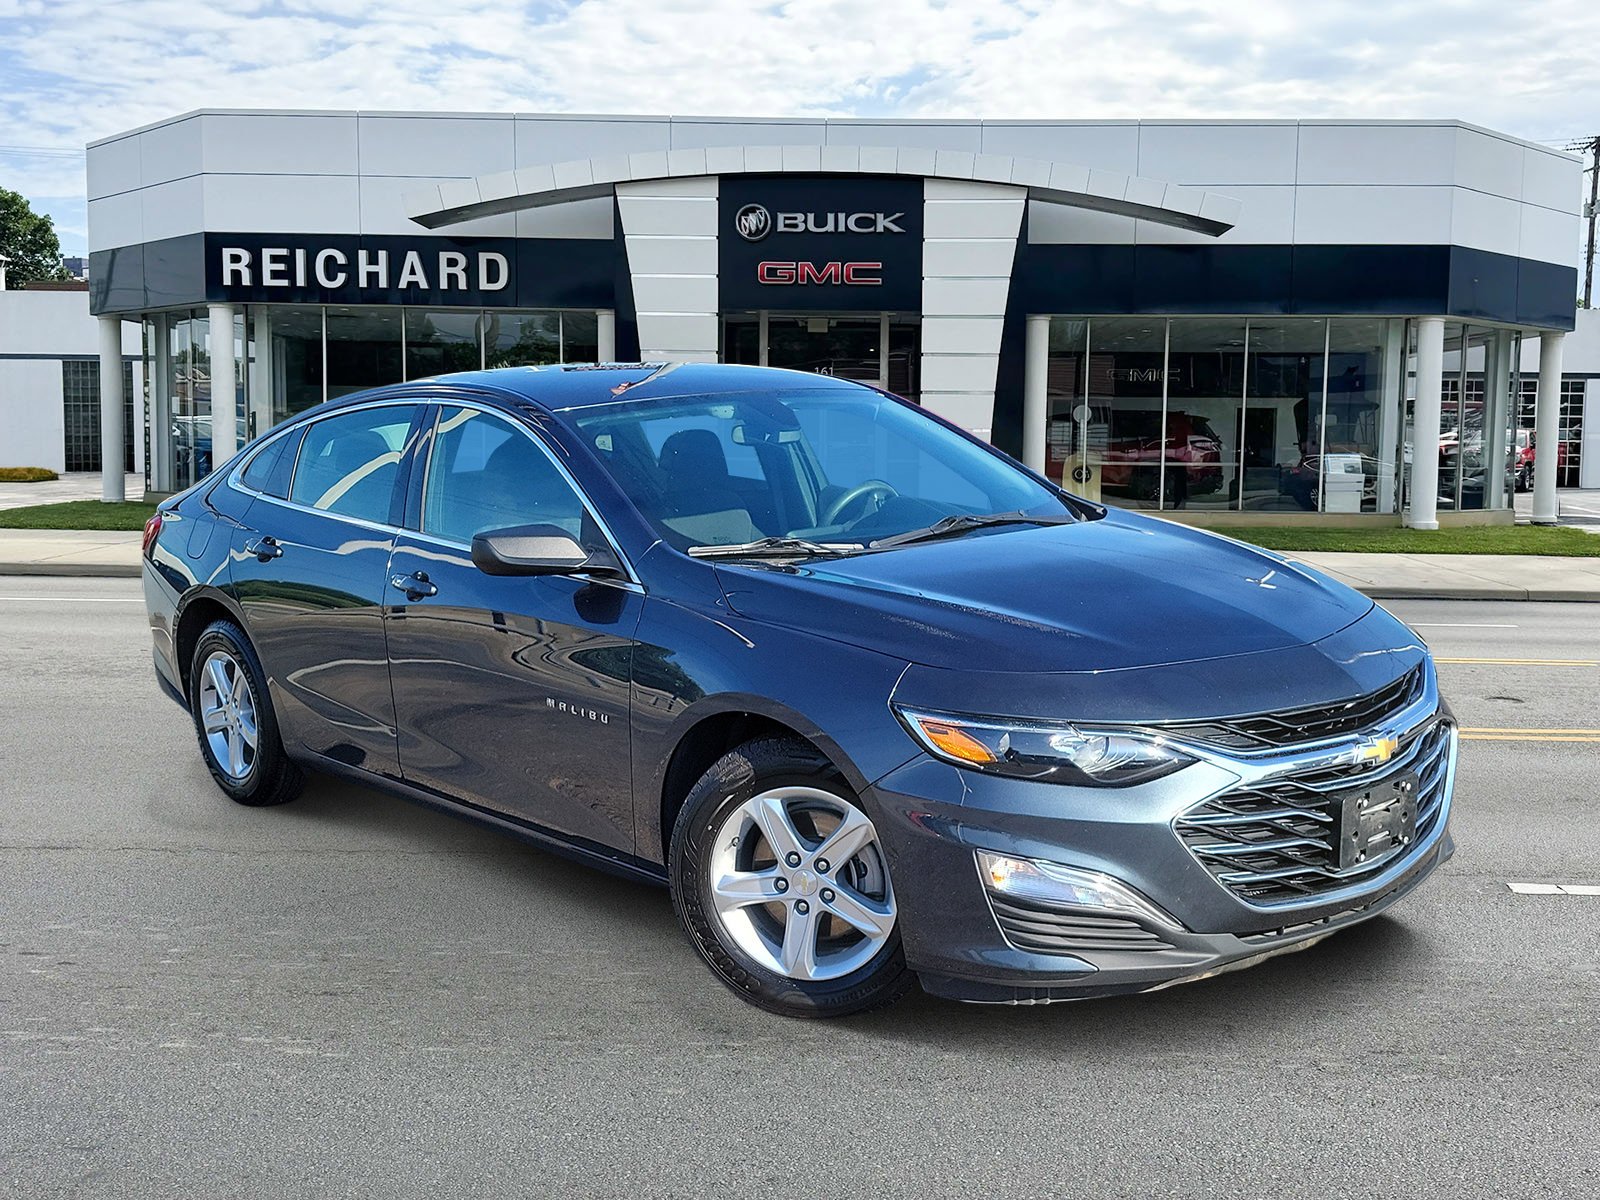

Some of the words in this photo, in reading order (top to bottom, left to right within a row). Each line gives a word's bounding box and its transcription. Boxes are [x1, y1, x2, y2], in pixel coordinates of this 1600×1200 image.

[776, 212, 906, 233] BUICK
[221, 247, 510, 291] REICHARD
[758, 261, 882, 285] GMC
[1106, 368, 1181, 382] GMC
[546, 697, 608, 724] MALIBU
